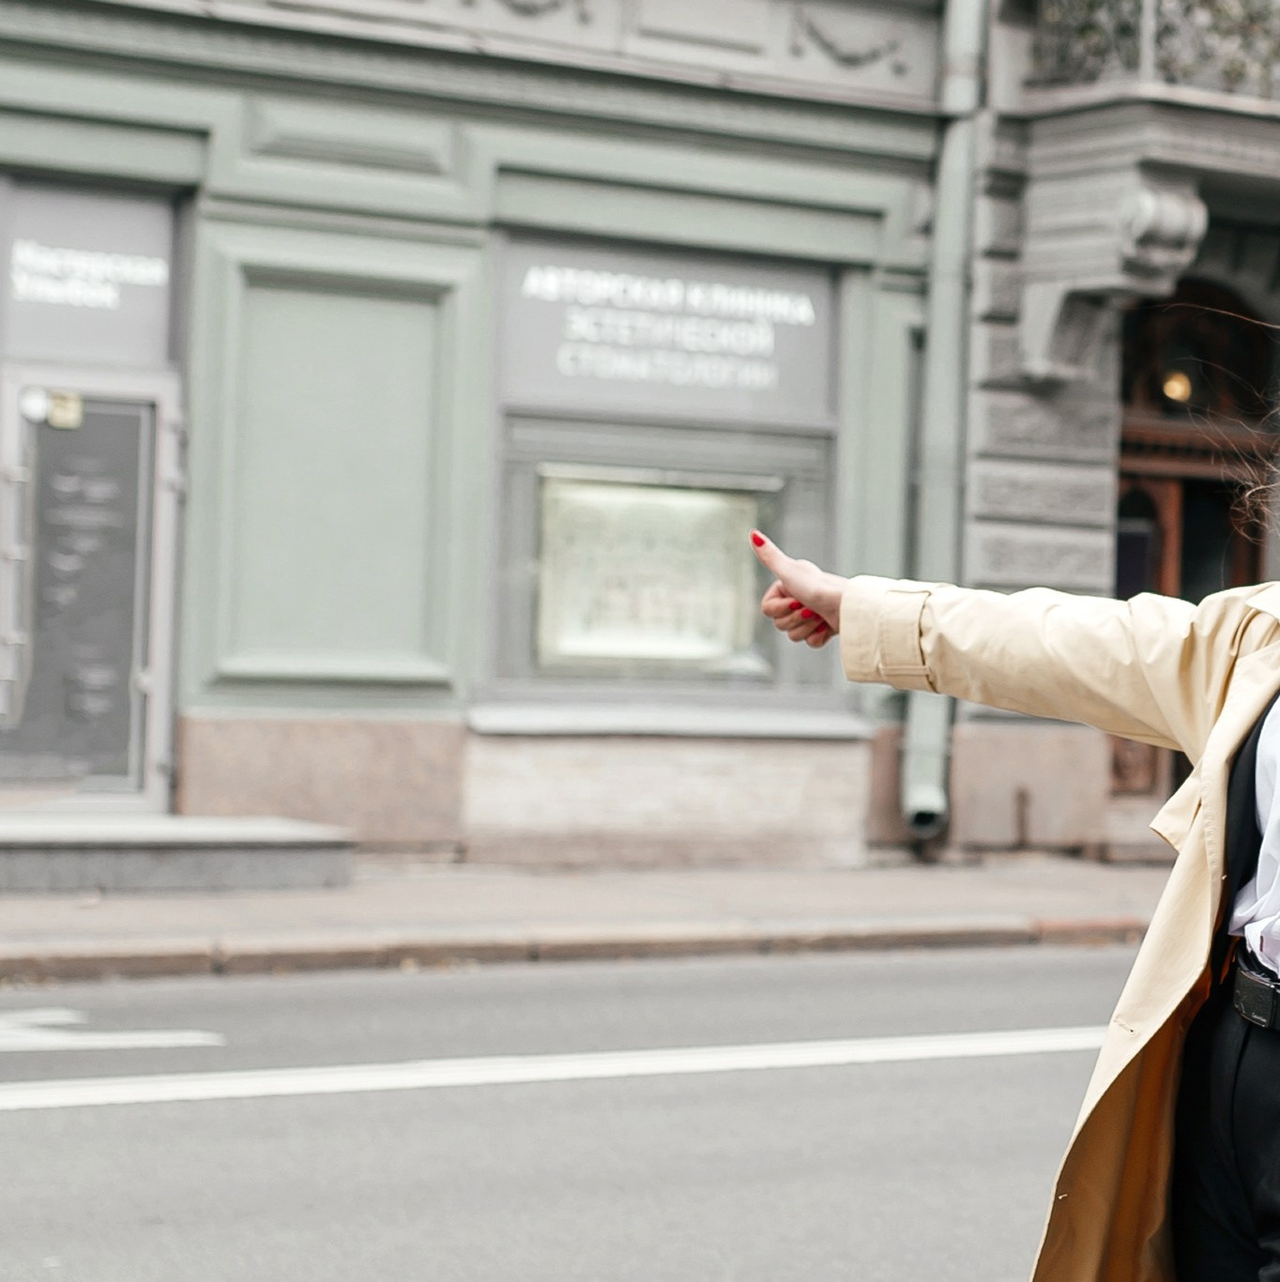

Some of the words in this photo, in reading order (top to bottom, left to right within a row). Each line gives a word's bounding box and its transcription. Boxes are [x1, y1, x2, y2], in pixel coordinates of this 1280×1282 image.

[521, 266, 684, 313] АВТОРСКАЯ
[686, 282, 815, 325] КЛИНИКА
[564, 305, 774, 357] ЭСТЕТИЧЕСКОЙ
[556, 341, 778, 389] СТОМАТОЛОГИИ
